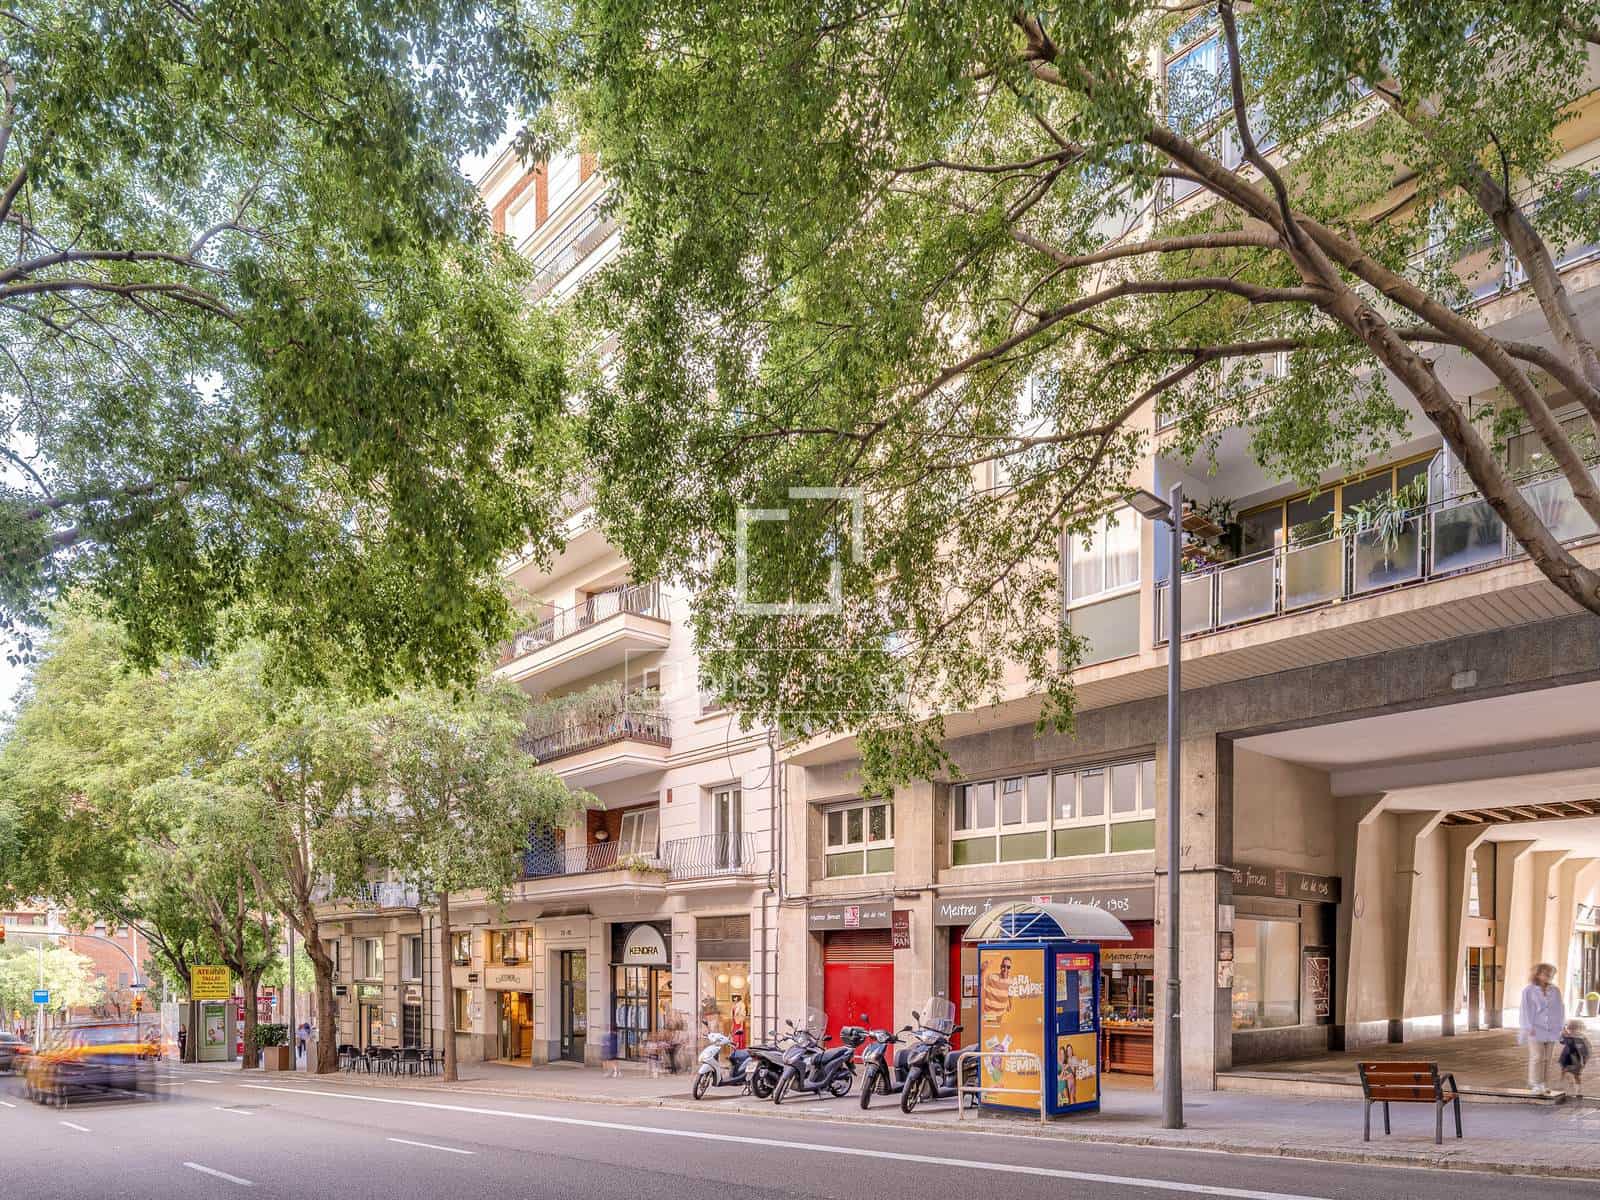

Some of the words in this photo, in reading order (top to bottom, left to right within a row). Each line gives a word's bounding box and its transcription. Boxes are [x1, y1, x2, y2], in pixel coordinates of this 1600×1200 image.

[940, 903, 977, 920] Mestres
[1107, 898, 1129, 911] 1903
[630, 946, 658, 956] KENDRA
[1008, 983, 1044, 999] SEMPRE
